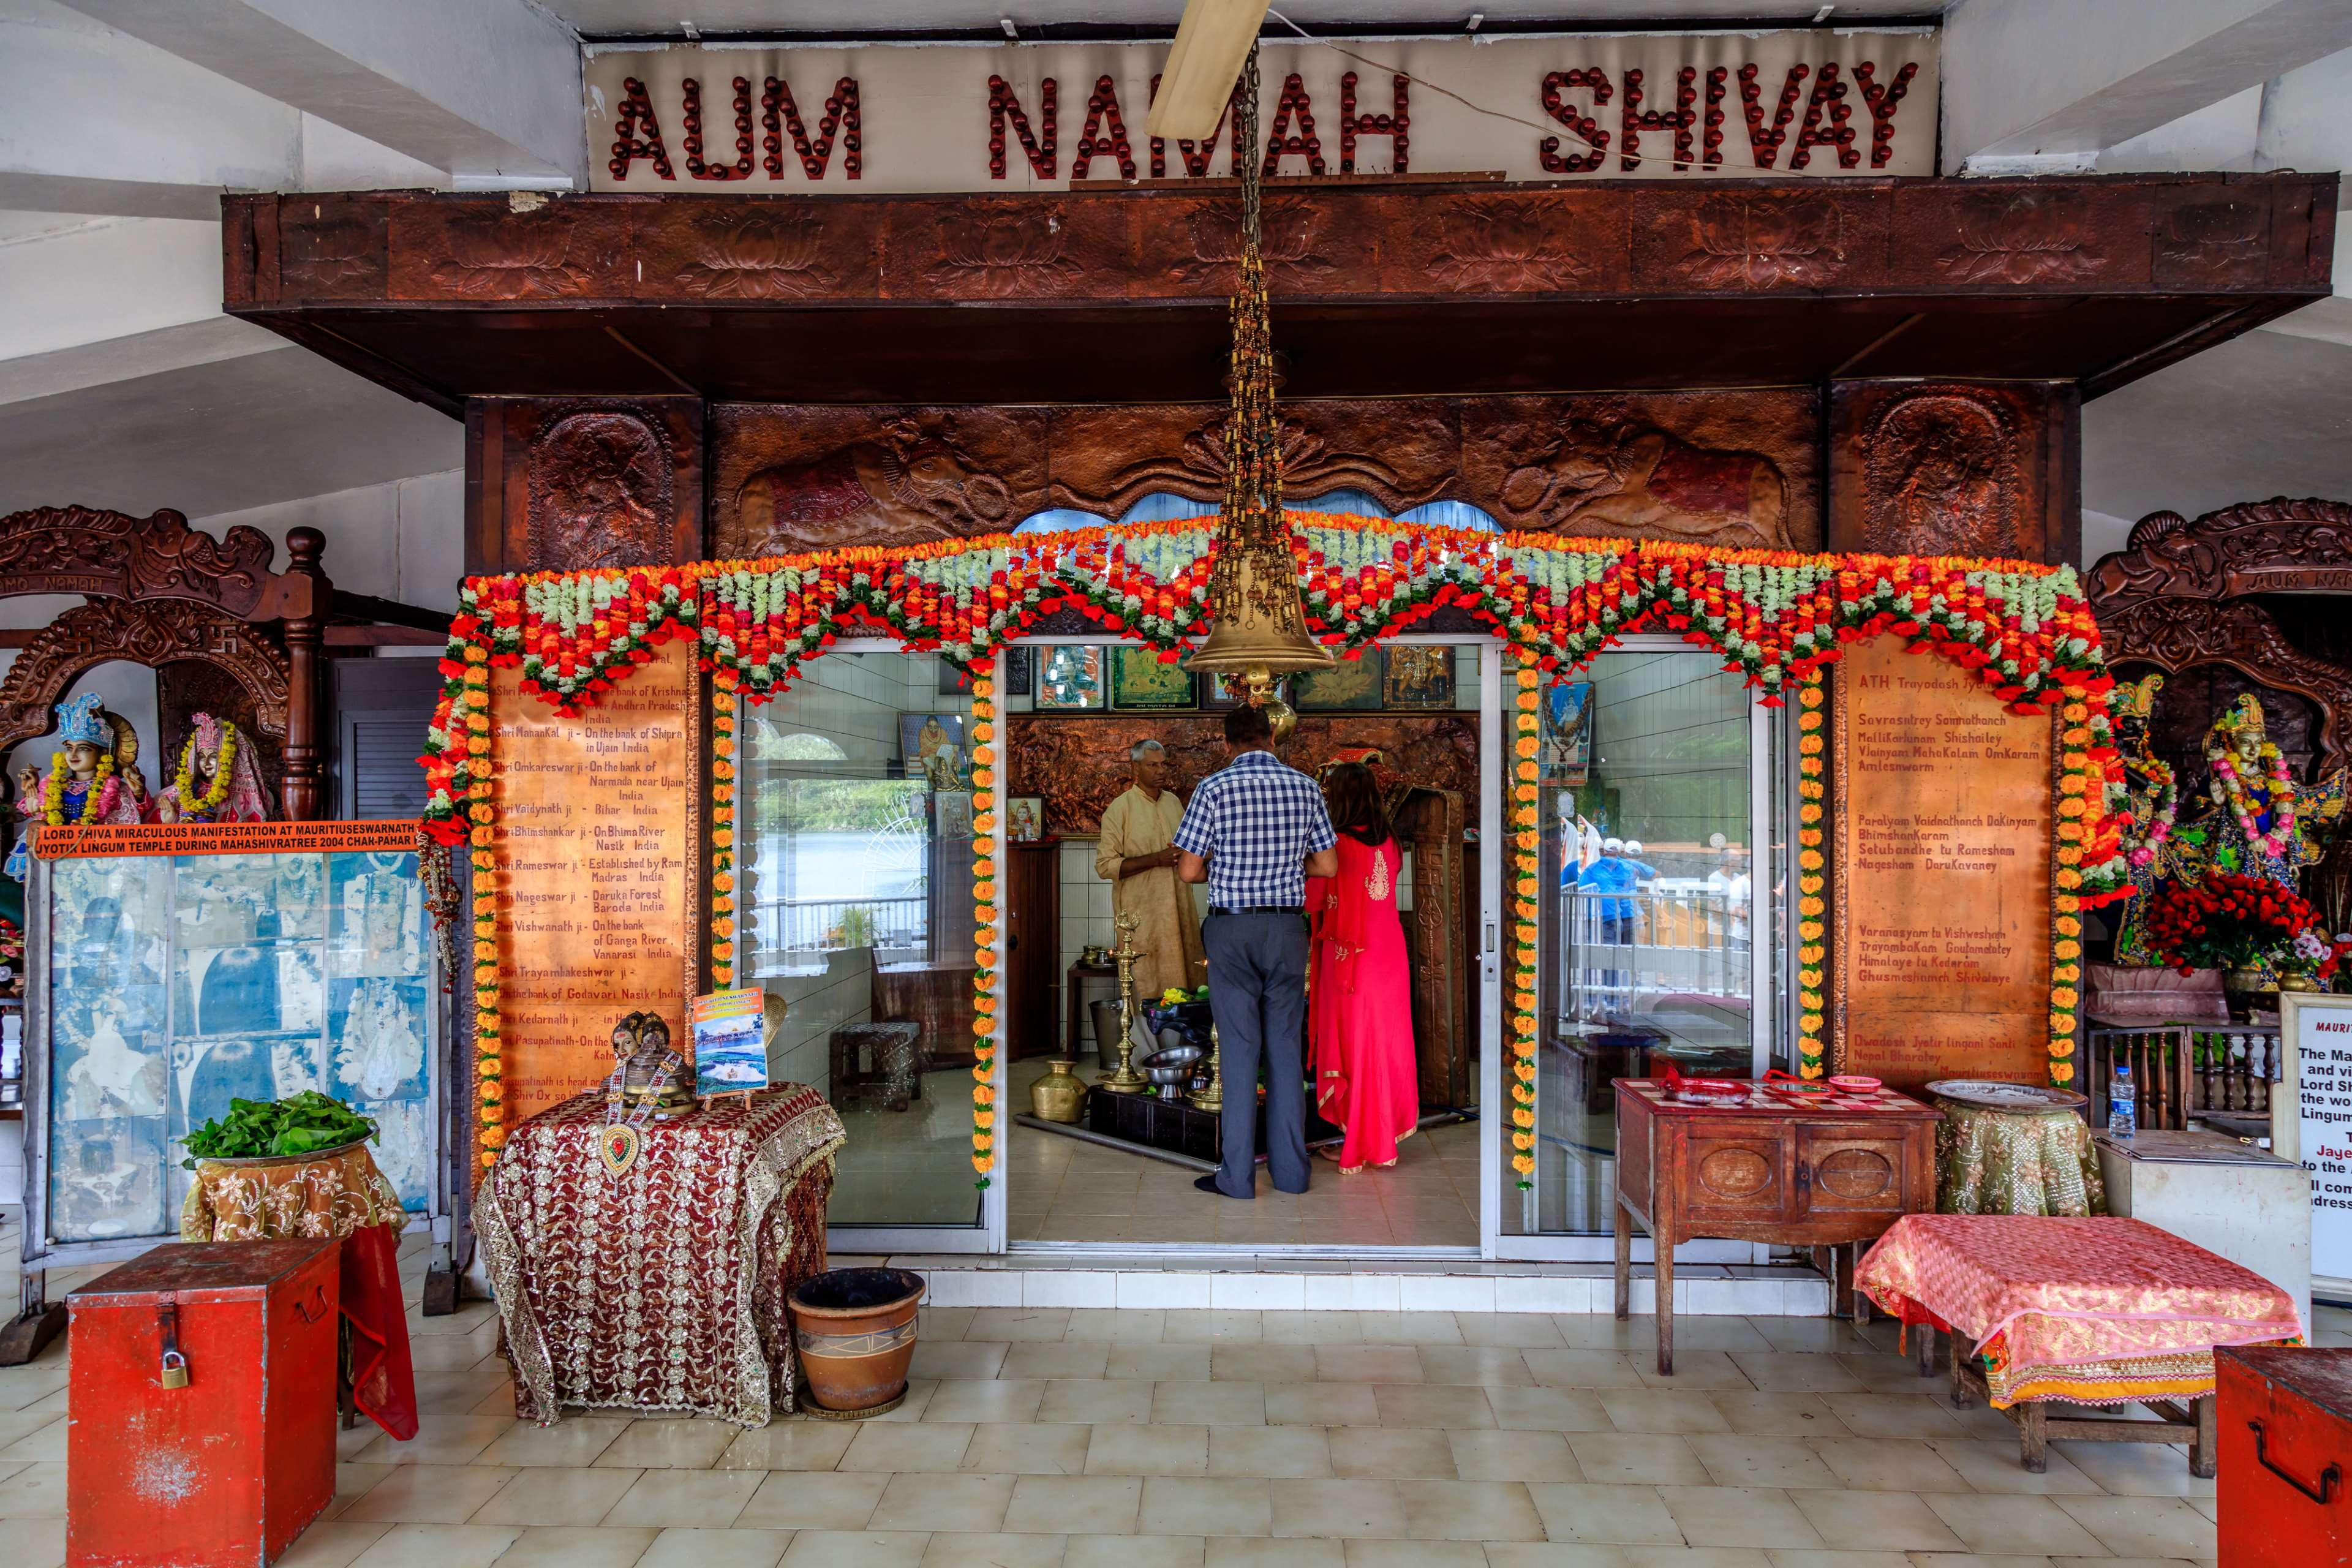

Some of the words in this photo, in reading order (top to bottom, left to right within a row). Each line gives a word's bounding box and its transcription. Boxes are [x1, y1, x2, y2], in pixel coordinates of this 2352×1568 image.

[609, 76, 861, 181] AUM
[1540, 62, 1918, 173] SHIVAY
[45, 577, 103, 591] NAMAH
[2247, 573, 2300, 590] AUM
[617, 685, 637, 696] bank
[652, 685, 687, 696] Krishna
[1860, 675, 1889, 688] ATH
[1898, 677, 1958, 693] Trayodash
[611, 700, 645, 710] Andhra
[649, 700, 686, 711] Pradesh
[586, 714, 611, 724] India
[496, 726, 514, 737] Shri
[568, 728, 573, 742] ji
[585, 727, 598, 738] On
[600, 727, 613, 739] the
[616, 728, 636, 739] bank
[641, 728, 650, 739] of
[652, 728, 682, 742] Shipra
[1945, 731, 2002, 747] Shishailey
[586, 743, 594, 753] in
[597, 741, 619, 756] Ujain
[623, 741, 649, 753] India
[494, 761, 513, 772] Shri
[514, 761, 574, 772] Omkareswar
[590, 761, 602, 772] On
[605, 761, 618, 772] the
[620, 761, 641, 772] bank
[646, 761, 657, 772] of
[590, 775, 632, 786] Narmada
[661, 776, 684, 790] Ujain
[619, 790, 644, 801] India
[494, 803, 513, 814] Shri
[515, 803, 562, 818] Vaidynath
[565, 805, 571, 818] ji
[595, 804, 620, 815] Bihar
[633, 804, 657, 815] India
[1859, 813, 1909, 829] Paralyam
[1914, 813, 1983, 826] Vaidnathanch
[44, 829, 74, 840] LORD
[78, 829, 111, 839] SHIVA
[116, 827, 187, 839] MIRACULOUS
[191, 826, 276, 837] MANIFESTATION
[279, 826, 292, 835] AT
[296, 824, 414, 835] MAURITIUSESWARNATH
[514, 826, 575, 837] Bhimshankar
[580, 826, 586, 840] ji
[594, 825, 606, 837] On
[608, 825, 637, 837] Bhima
[639, 825, 665, 837] River
[36, 843, 77, 854] JYOTIR
[81, 842, 125, 853] LINGUM
[129, 841, 172, 851] TEMPLE
[176, 840, 216, 851] DURING
[221, 838, 316, 850] MAHASHIVRATREE
[320, 837, 343, 847] 2004
[597, 839, 625, 851] Nasik
[635, 839, 659, 850] India
[1859, 843, 1932, 855] Setubandhe
[1940, 843, 1951, 855] tu
[1958, 843, 2015, 856] Ramesham
[495, 860, 513, 870] Shri
[516, 859, 568, 870] Rameswar
[589, 858, 644, 869] Established
[647, 858, 660, 872] by
[662, 857, 682, 869] Ram
[1858, 858, 1915, 873] Nagesham
[592, 872, 627, 882] Madras
[640, 872, 665, 881] India
[495, 891, 513, 902] Shri
[516, 891, 567, 905] Nageswar
[570, 892, 576, 904] ji
[593, 889, 627, 901] Daruka
[630, 888, 662, 900] Forest
[594, 902, 631, 913] Baroda
[640, 902, 665, 912] India
[496, 921, 513, 932] Shri
[514, 920, 573, 932] Vishwanath
[576, 922, 582, 935] ji
[593, 919, 605, 931] On
[607, 919, 621, 930] the
[623, 919, 644, 930] bank
[1860, 925, 1928, 941] Varanasyam
[1932, 927, 1940, 938] tu
[1945, 926, 2006, 939] Vishwesham
[594, 934, 603, 946] of
[606, 933, 637, 948] Ganga
[641, 933, 667, 945] River
[593, 949, 636, 959] Vanarasi
[647, 948, 671, 959] India
[1859, 954, 1912, 970] Himalaye
[1917, 956, 1928, 967] tu
[499, 967, 517, 977] Shri
[620, 967, 626, 980] ji
[1956, 971, 2010, 987] Shivalaye
[528, 987, 548, 998] bank
[551, 988, 562, 999] of
[568, 987, 616, 999] Godavari
[622, 988, 649, 999] Nasik
[658, 987, 683, 998] India
[519, 1012, 568, 1024] Kedarnath
[572, 1014, 578, 1027] ji
[604, 1014, 612, 1023] in
[595, 1035, 608, 1046] the
[1854, 1049, 1885, 1063] Nepal
[1890, 1050, 1940, 1066] Bharatey
[2299, 1047, 2326, 1060] The
[2307, 1065, 2334, 1076] and
[556, 1077, 564, 1086] is
[568, 1076, 587, 1086] head
[2301, 1078, 2333, 1091] Lord
[513, 1090, 533, 1100] Shiv
[537, 1090, 550, 1101] Ox
[555, 1092, 566, 1101] so
[2301, 1093, 2324, 1105] the
[2302, 1159, 2316, 1171] to
[2321, 1161, 2346, 1174] the
